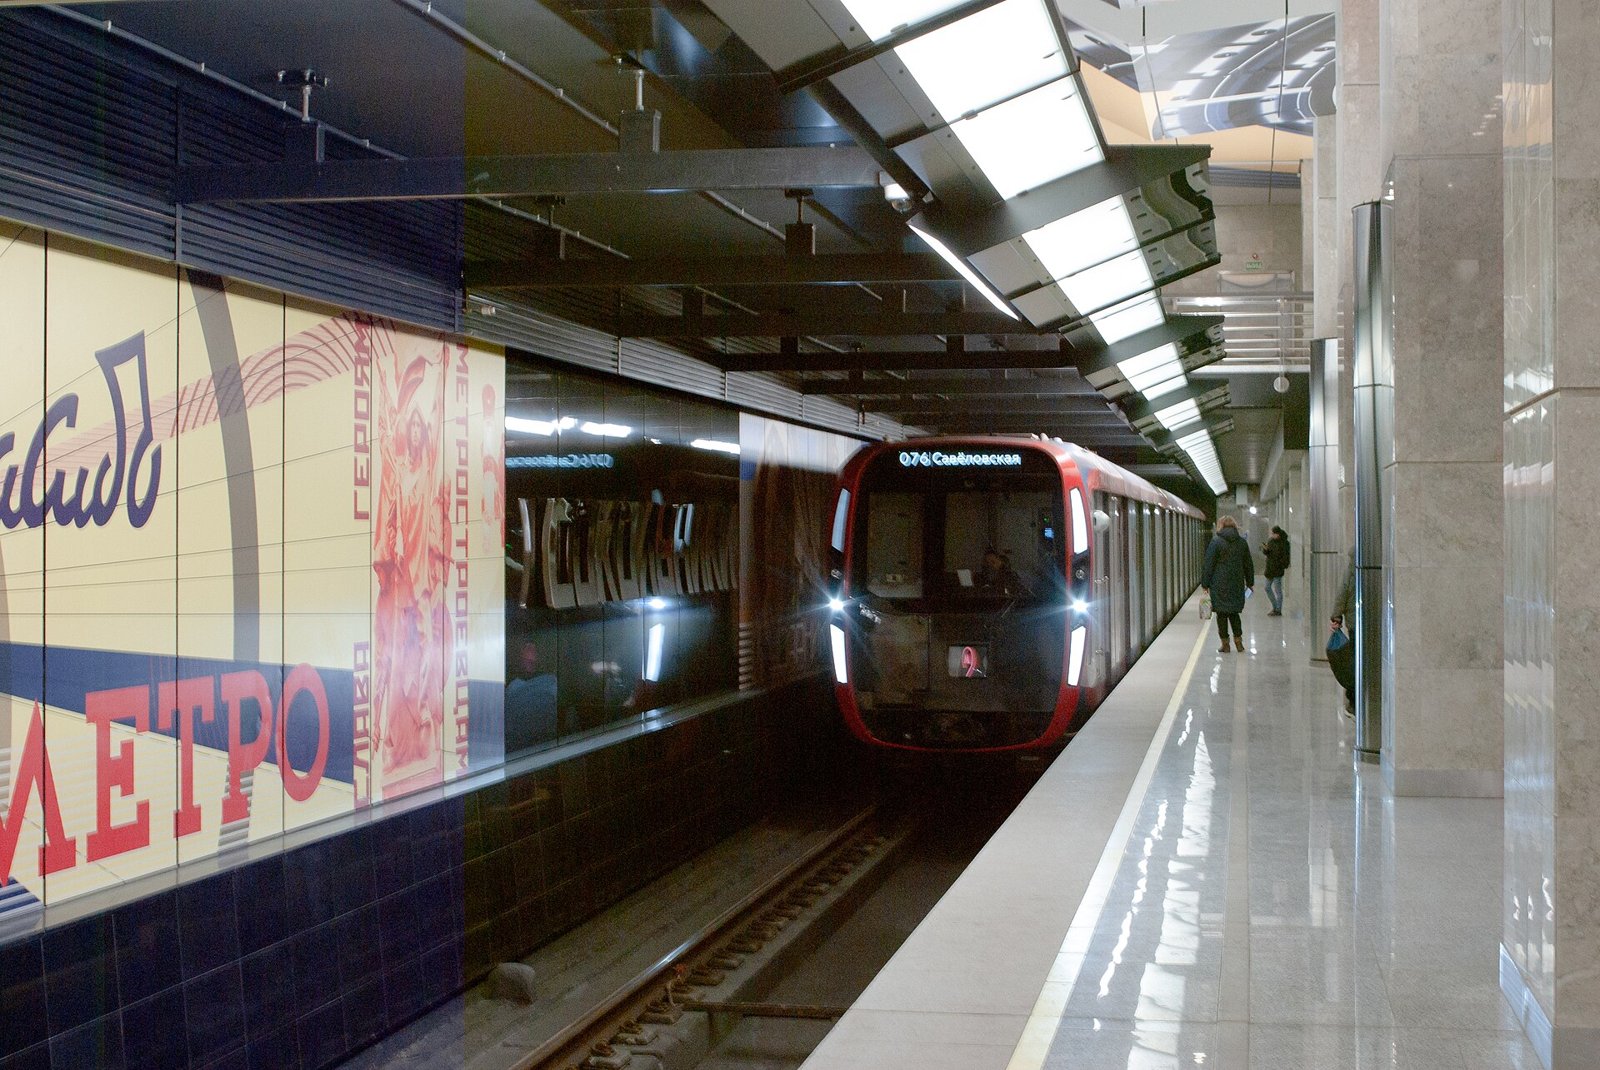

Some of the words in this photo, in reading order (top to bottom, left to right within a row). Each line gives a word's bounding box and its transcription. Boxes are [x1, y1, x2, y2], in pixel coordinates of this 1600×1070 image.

[354, 318, 370, 520] ГЕРОЯМ
[899, 451, 931, 467] 076
[932, 451, 1022, 466] Савёловская
[454, 342, 469, 778] МЕТРОСТРОЕВЦАМ
[353, 641, 369, 811] СЛАВА
